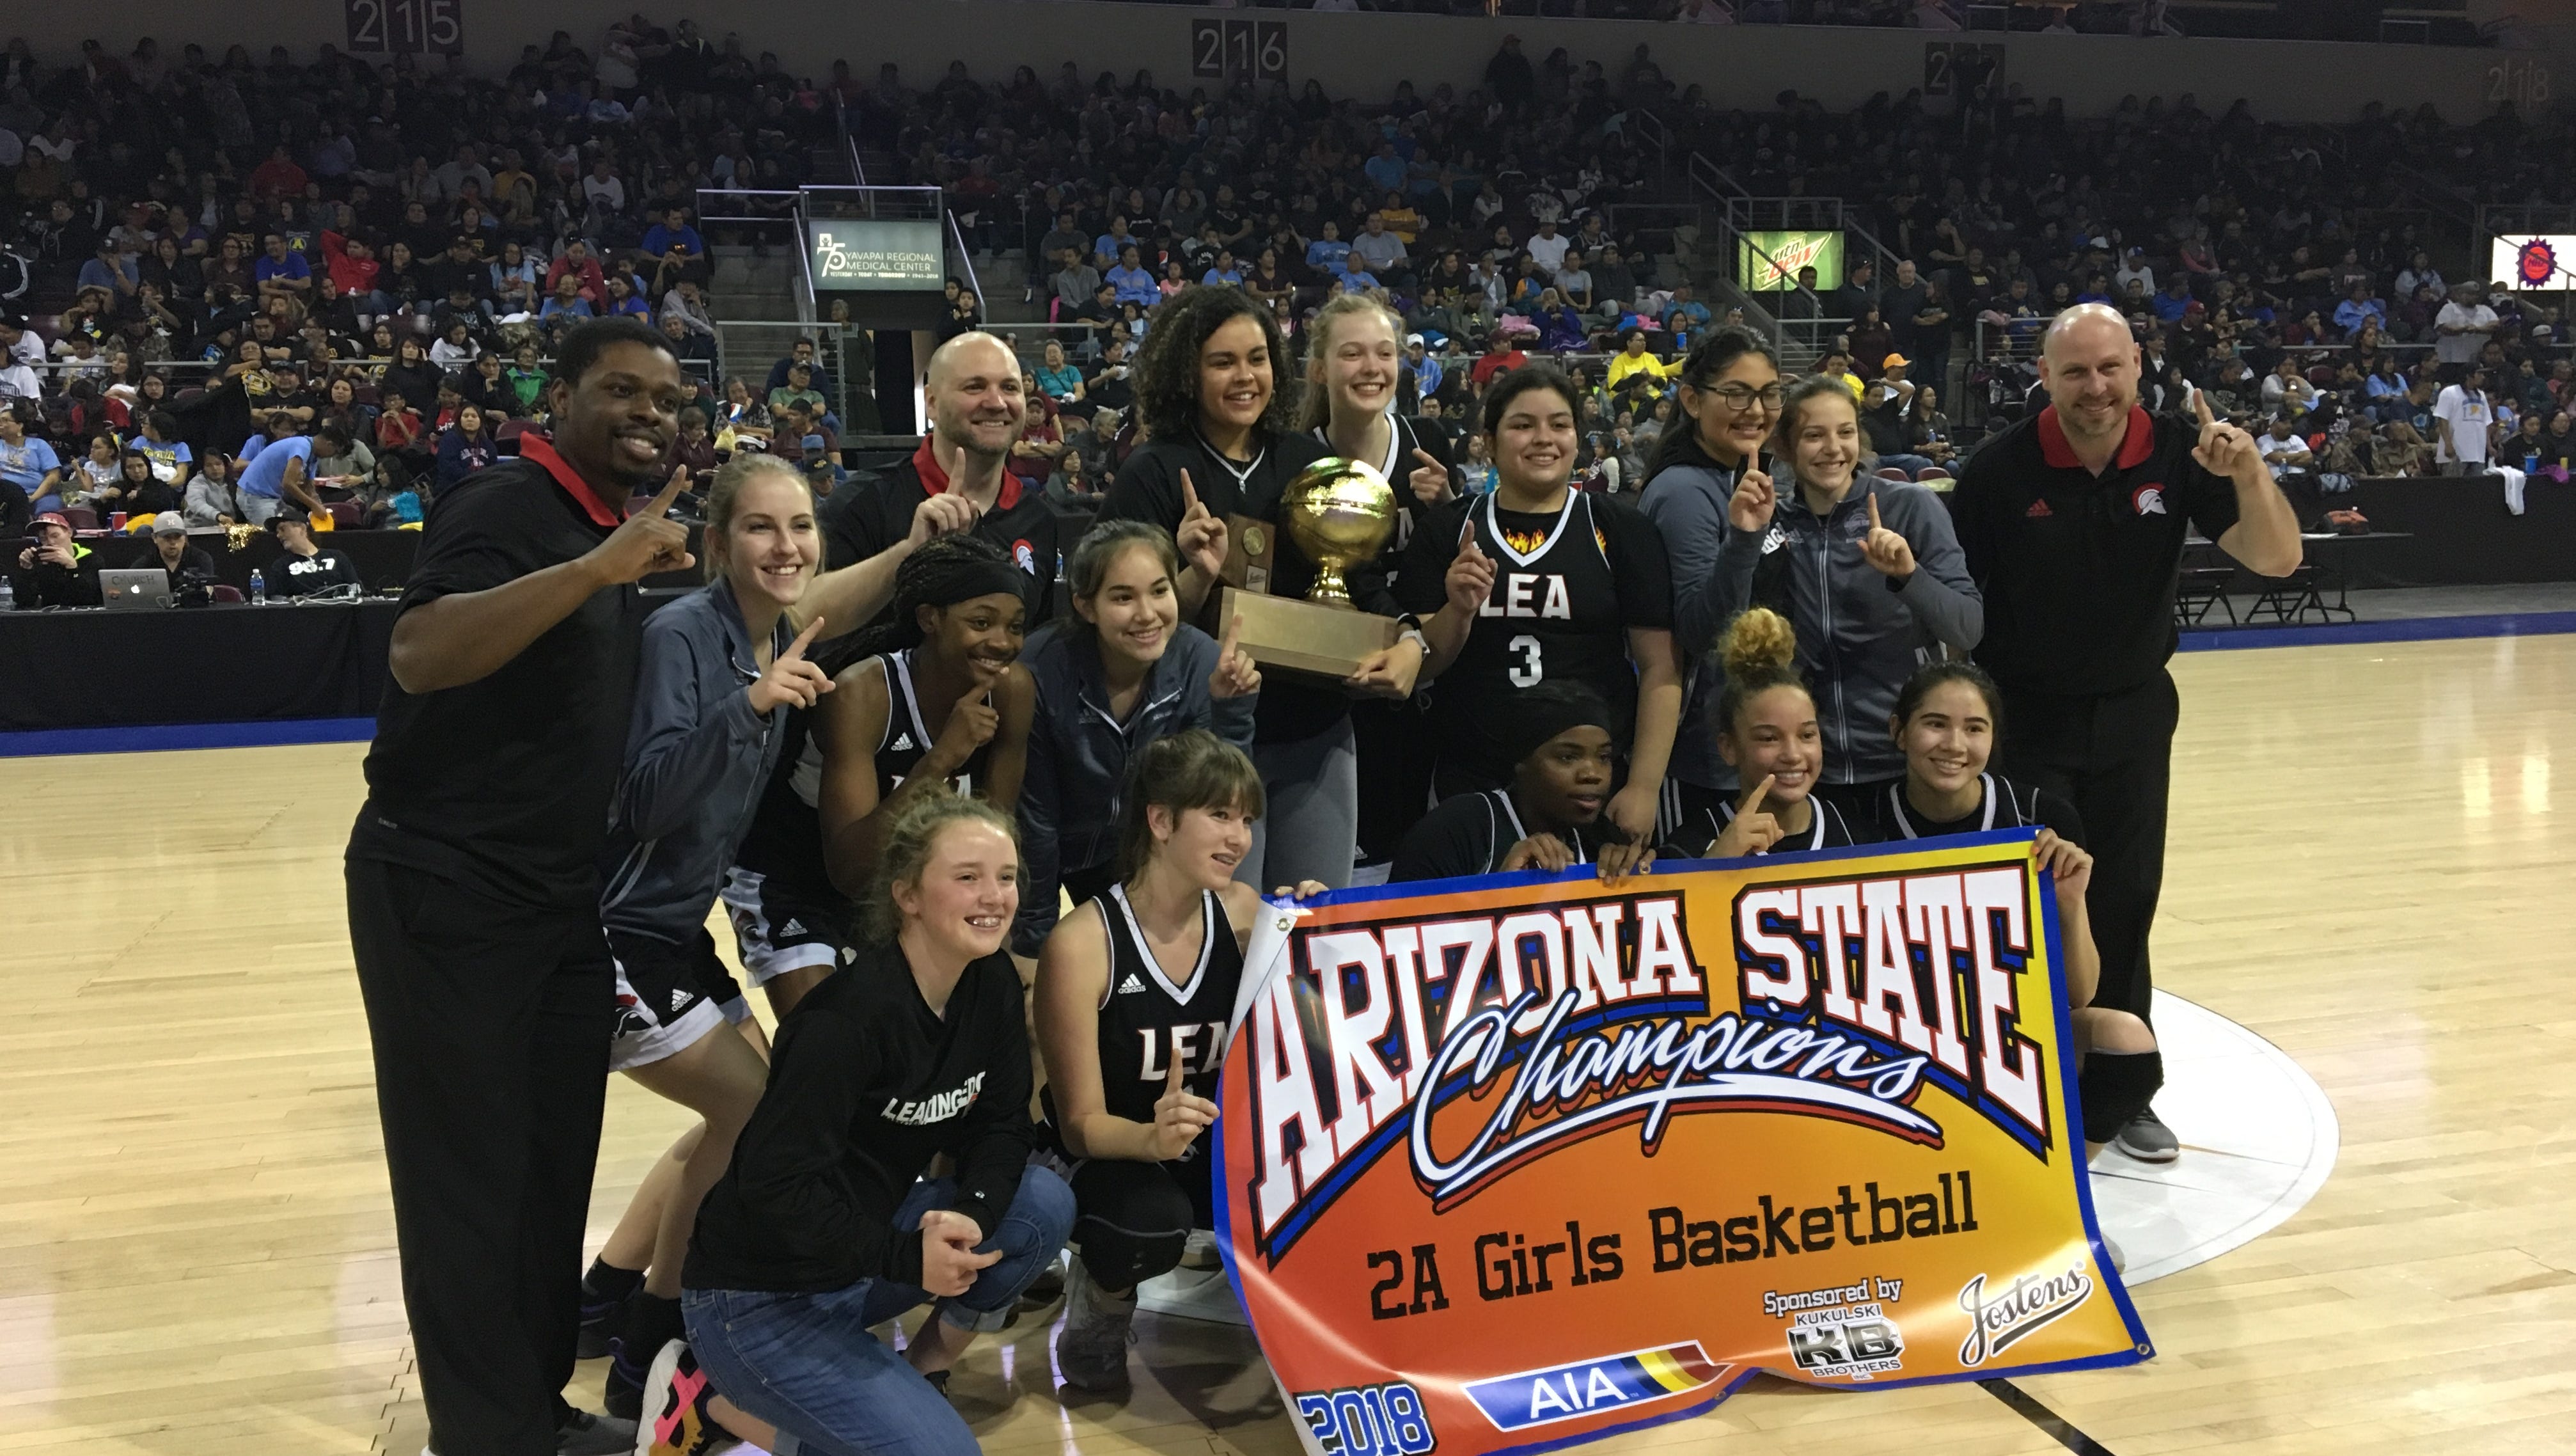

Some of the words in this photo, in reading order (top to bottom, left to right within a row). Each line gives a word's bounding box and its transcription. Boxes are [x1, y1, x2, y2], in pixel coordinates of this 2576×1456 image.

[352, 0, 459, 45] 215
[1198, 28, 1285, 72] 216
[845, 251, 884, 260] YAVAPAI
[886, 252, 937, 262] REGIONAL
[846, 261, 891, 271] MEDICAL
[893, 262, 931, 272] CENTER
[1509, 635, 1543, 688] 3
[671, 992, 695, 1012] adidas
[1118, 985, 1147, 994] adidas
[1255, 897, 1701, 1235] ARIZONA
[1738, 866, 2045, 1135] STATE
[1411, 988, 1929, 1185] Champions
[1367, 1243, 1450, 1321] 2A
[1474, 1220, 1624, 1302] Girls
[1647, 1170, 1979, 1274] Basketball
[1763, 1278, 1871, 1319] Sponsored
[1874, 1276, 1903, 1302] by
[1796, 1304, 1882, 1326] KUKULSKI
[1960, 1269, 2084, 1365] Jostens
[1787, 1317, 1905, 1369] KB
[1812, 1359, 1901, 1377] BROTHERS
[1530, 1367, 1630, 1419] AIA
[1297, 1382, 1435, 1456] 2018
